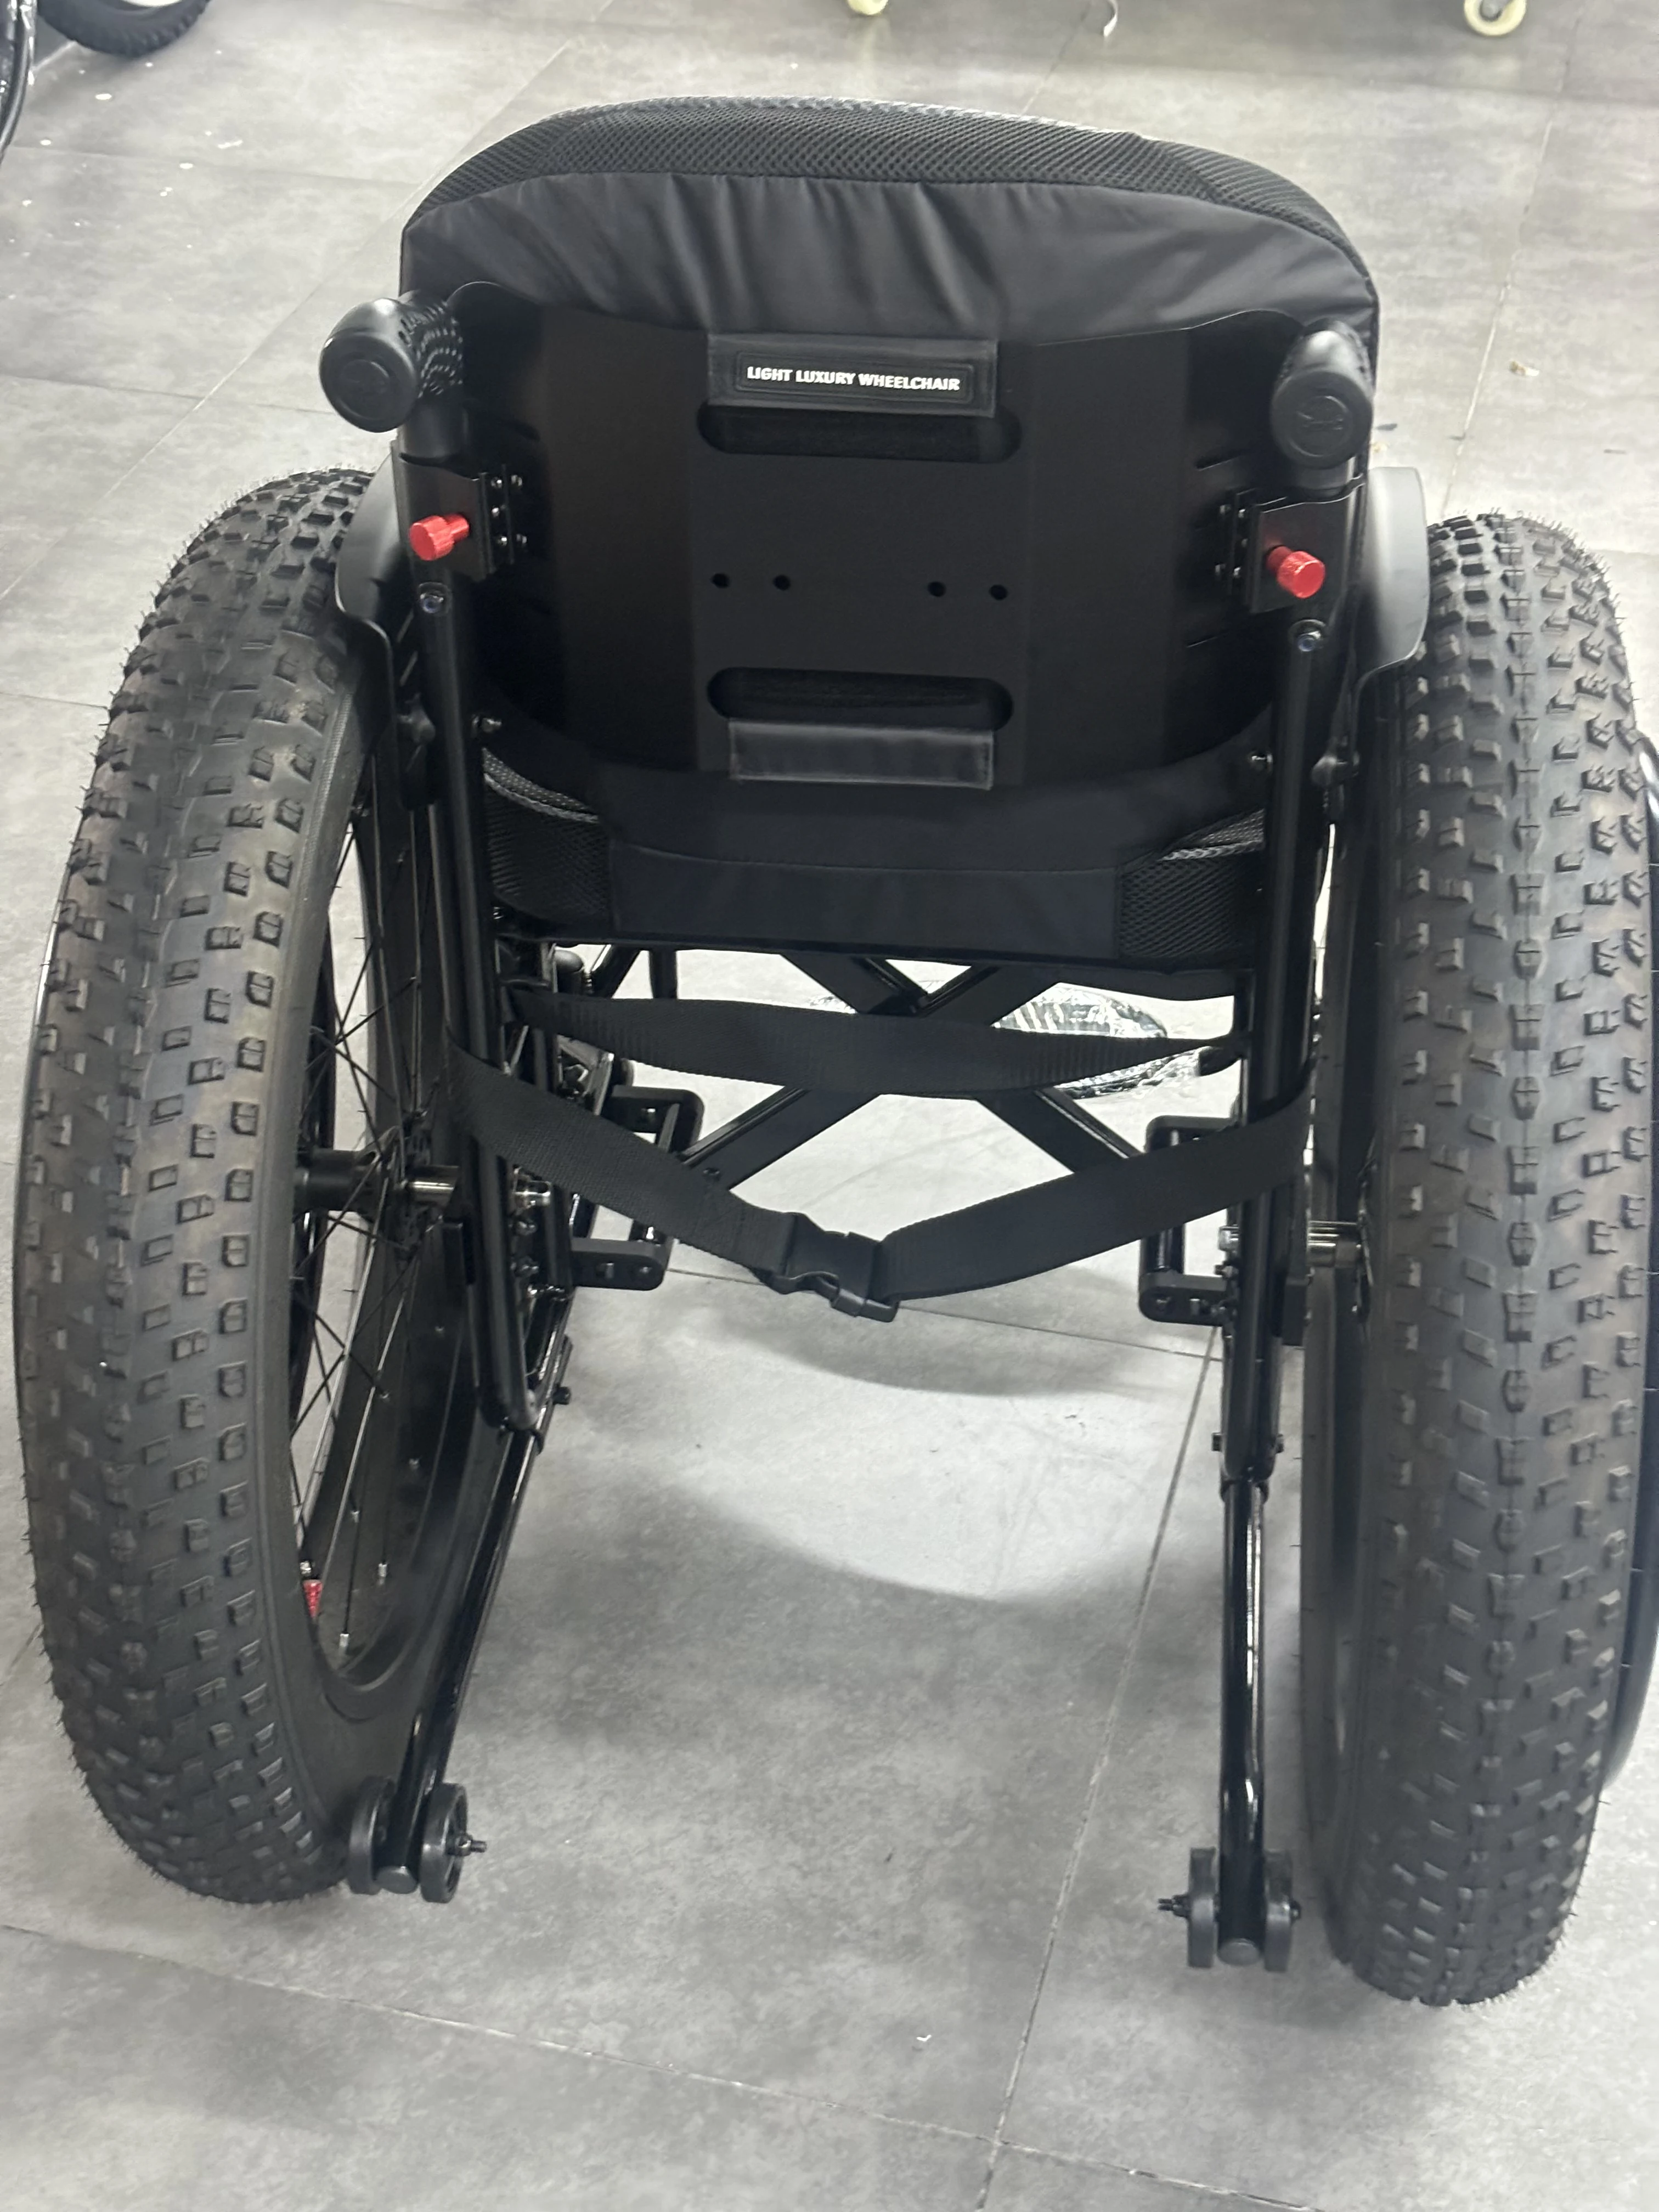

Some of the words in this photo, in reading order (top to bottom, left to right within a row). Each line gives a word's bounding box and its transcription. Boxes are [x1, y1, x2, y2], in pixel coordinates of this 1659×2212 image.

[747, 366, 793, 382] LIGHT
[795, 370, 856, 385] LUXURY
[857, 373, 961, 391] WHEELCHAIR
